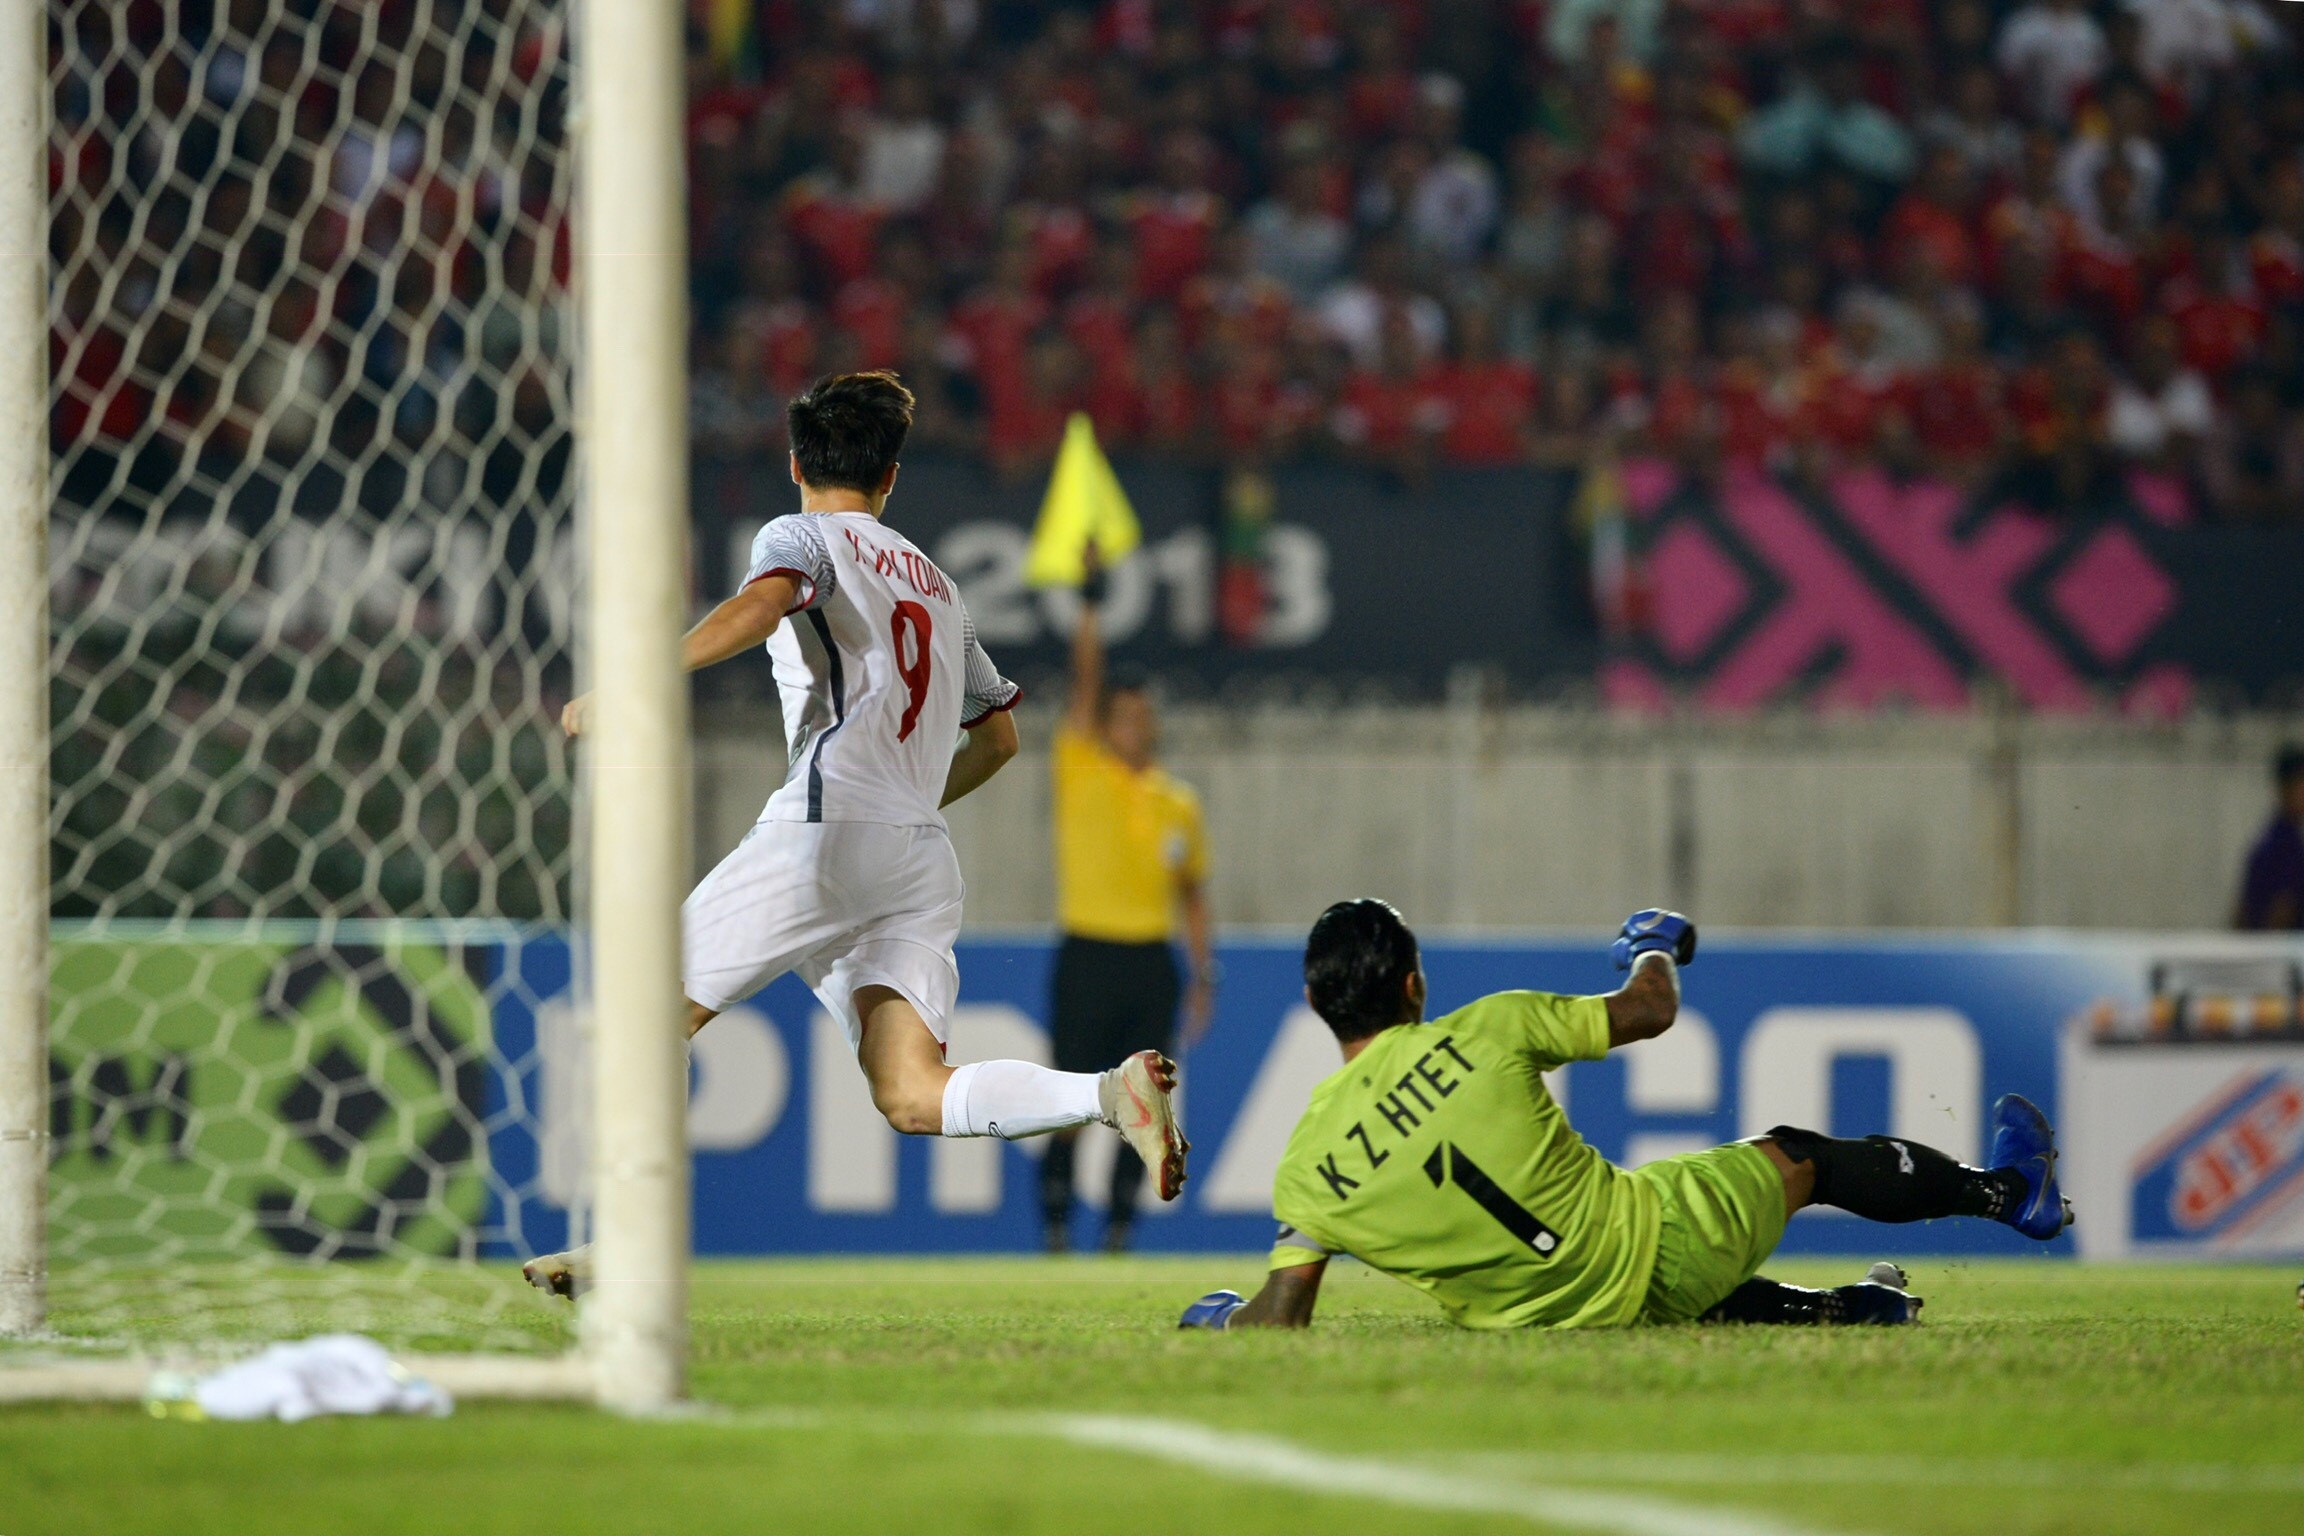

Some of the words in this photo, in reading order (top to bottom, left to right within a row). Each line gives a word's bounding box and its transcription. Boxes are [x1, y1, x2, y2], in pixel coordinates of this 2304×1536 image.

[891, 600, 932, 744] 9
[1316, 1152, 1360, 1201] K
[1345, 1121, 1391, 1170] Z
[1375, 1035, 1476, 1138] HTET
[1422, 1140, 1564, 1260] 1
